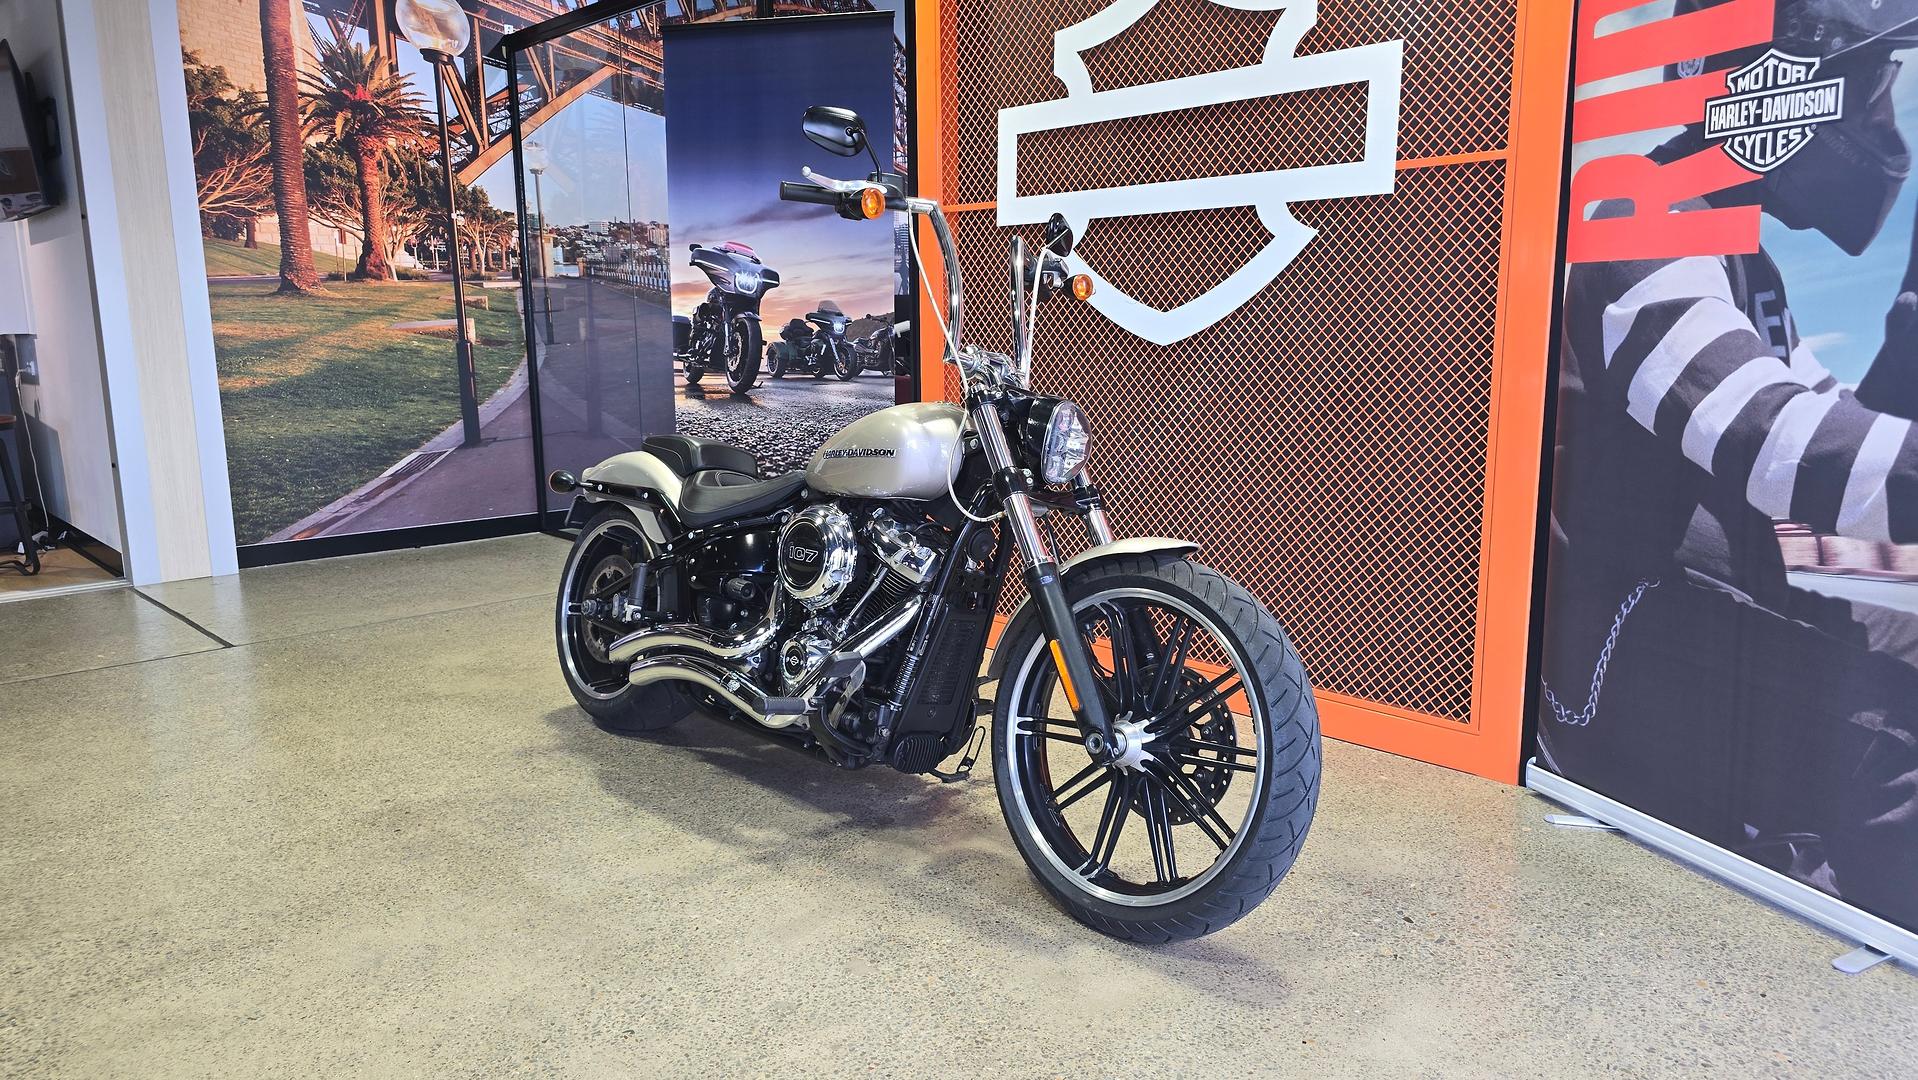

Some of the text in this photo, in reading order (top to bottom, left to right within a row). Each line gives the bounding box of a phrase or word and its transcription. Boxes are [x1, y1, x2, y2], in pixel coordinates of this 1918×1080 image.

[1737, 56, 1808, 92] MOTOR
[1710, 85, 1838, 131] HARLEY-DAVIDSON
[1733, 126, 1802, 165] CYCLES
[822, 448, 897, 460] HARLEY-DAVIDSON
[788, 545, 819, 563] 107
